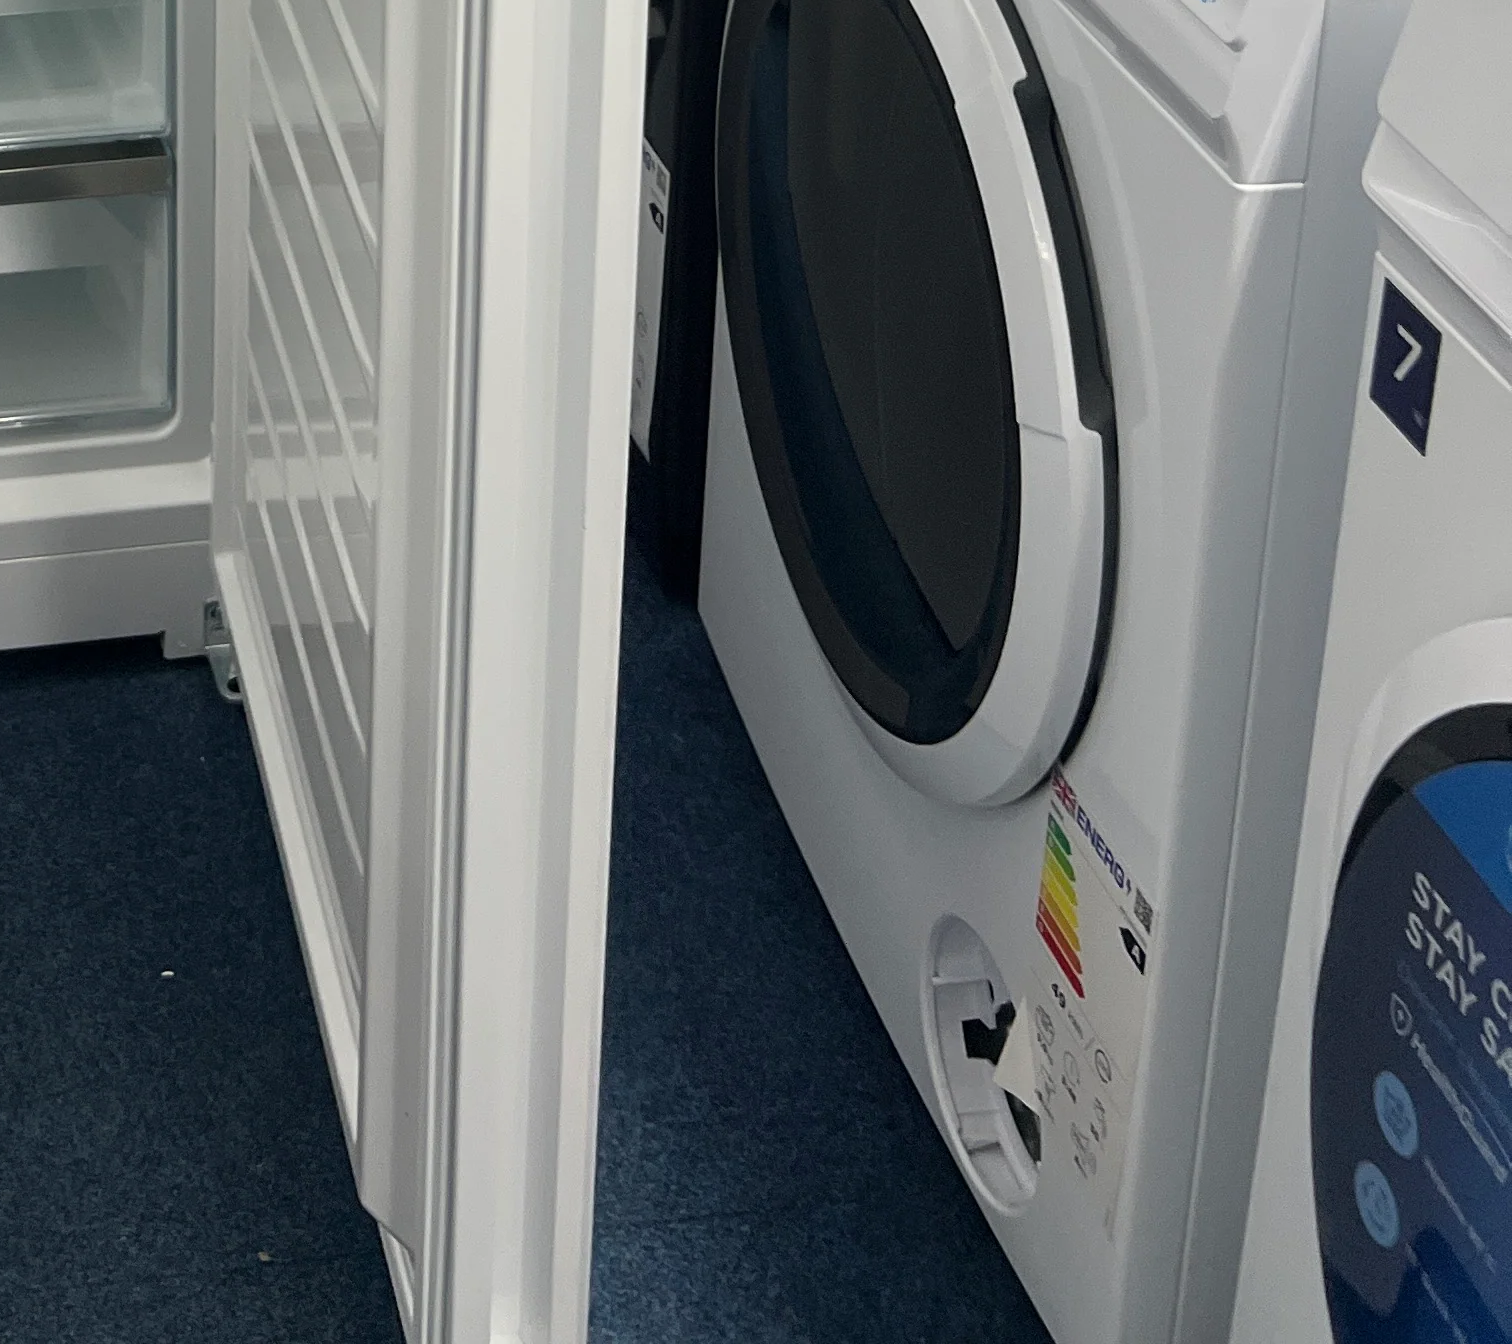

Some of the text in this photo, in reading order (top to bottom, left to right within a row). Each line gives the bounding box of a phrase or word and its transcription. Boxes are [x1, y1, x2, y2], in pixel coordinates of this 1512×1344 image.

[1077, 805, 1126, 889] ENERG
[1405, 913, 1478, 1016] STAY
[1412, 872, 1486, 976] STAY
